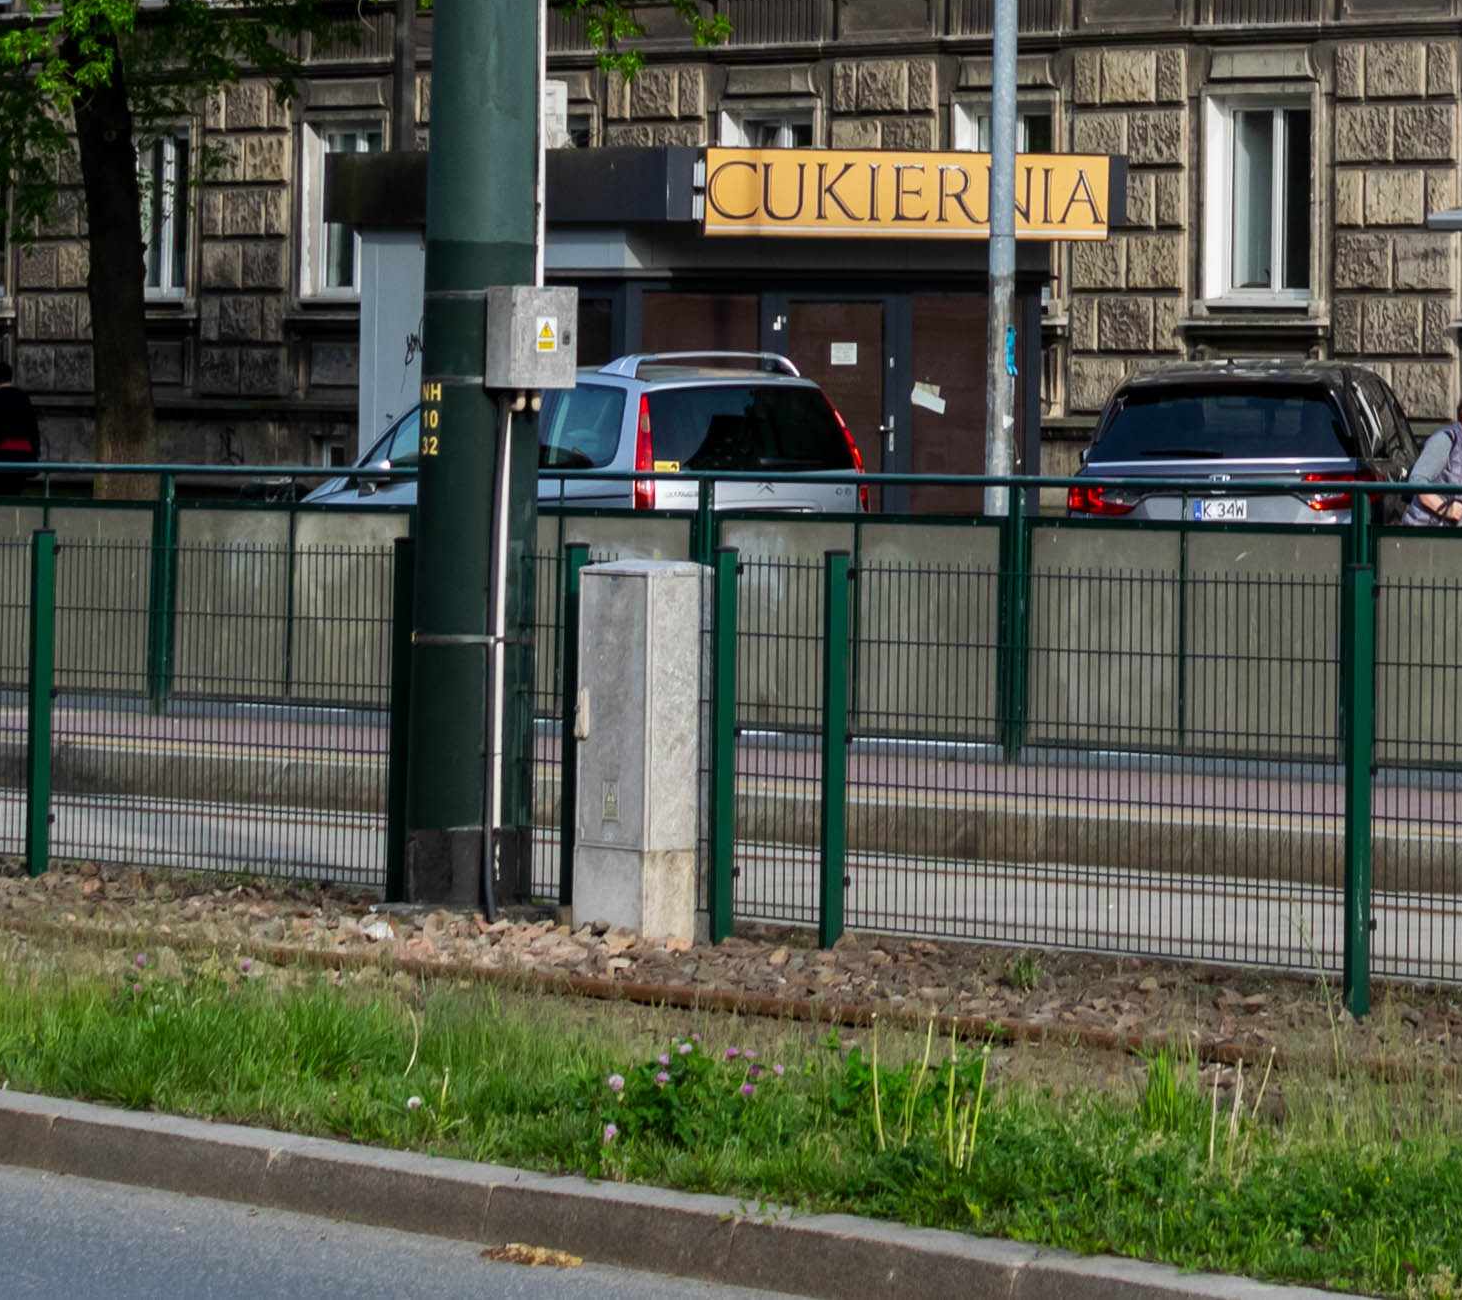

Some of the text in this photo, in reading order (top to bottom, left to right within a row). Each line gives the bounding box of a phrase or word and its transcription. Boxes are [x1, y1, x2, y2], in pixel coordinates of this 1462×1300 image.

[422, 382, 442, 402] NH
[423, 409, 439, 429] 10
[422, 435, 439, 456] 32
[1203, 501, 1244, 518] K 34W
